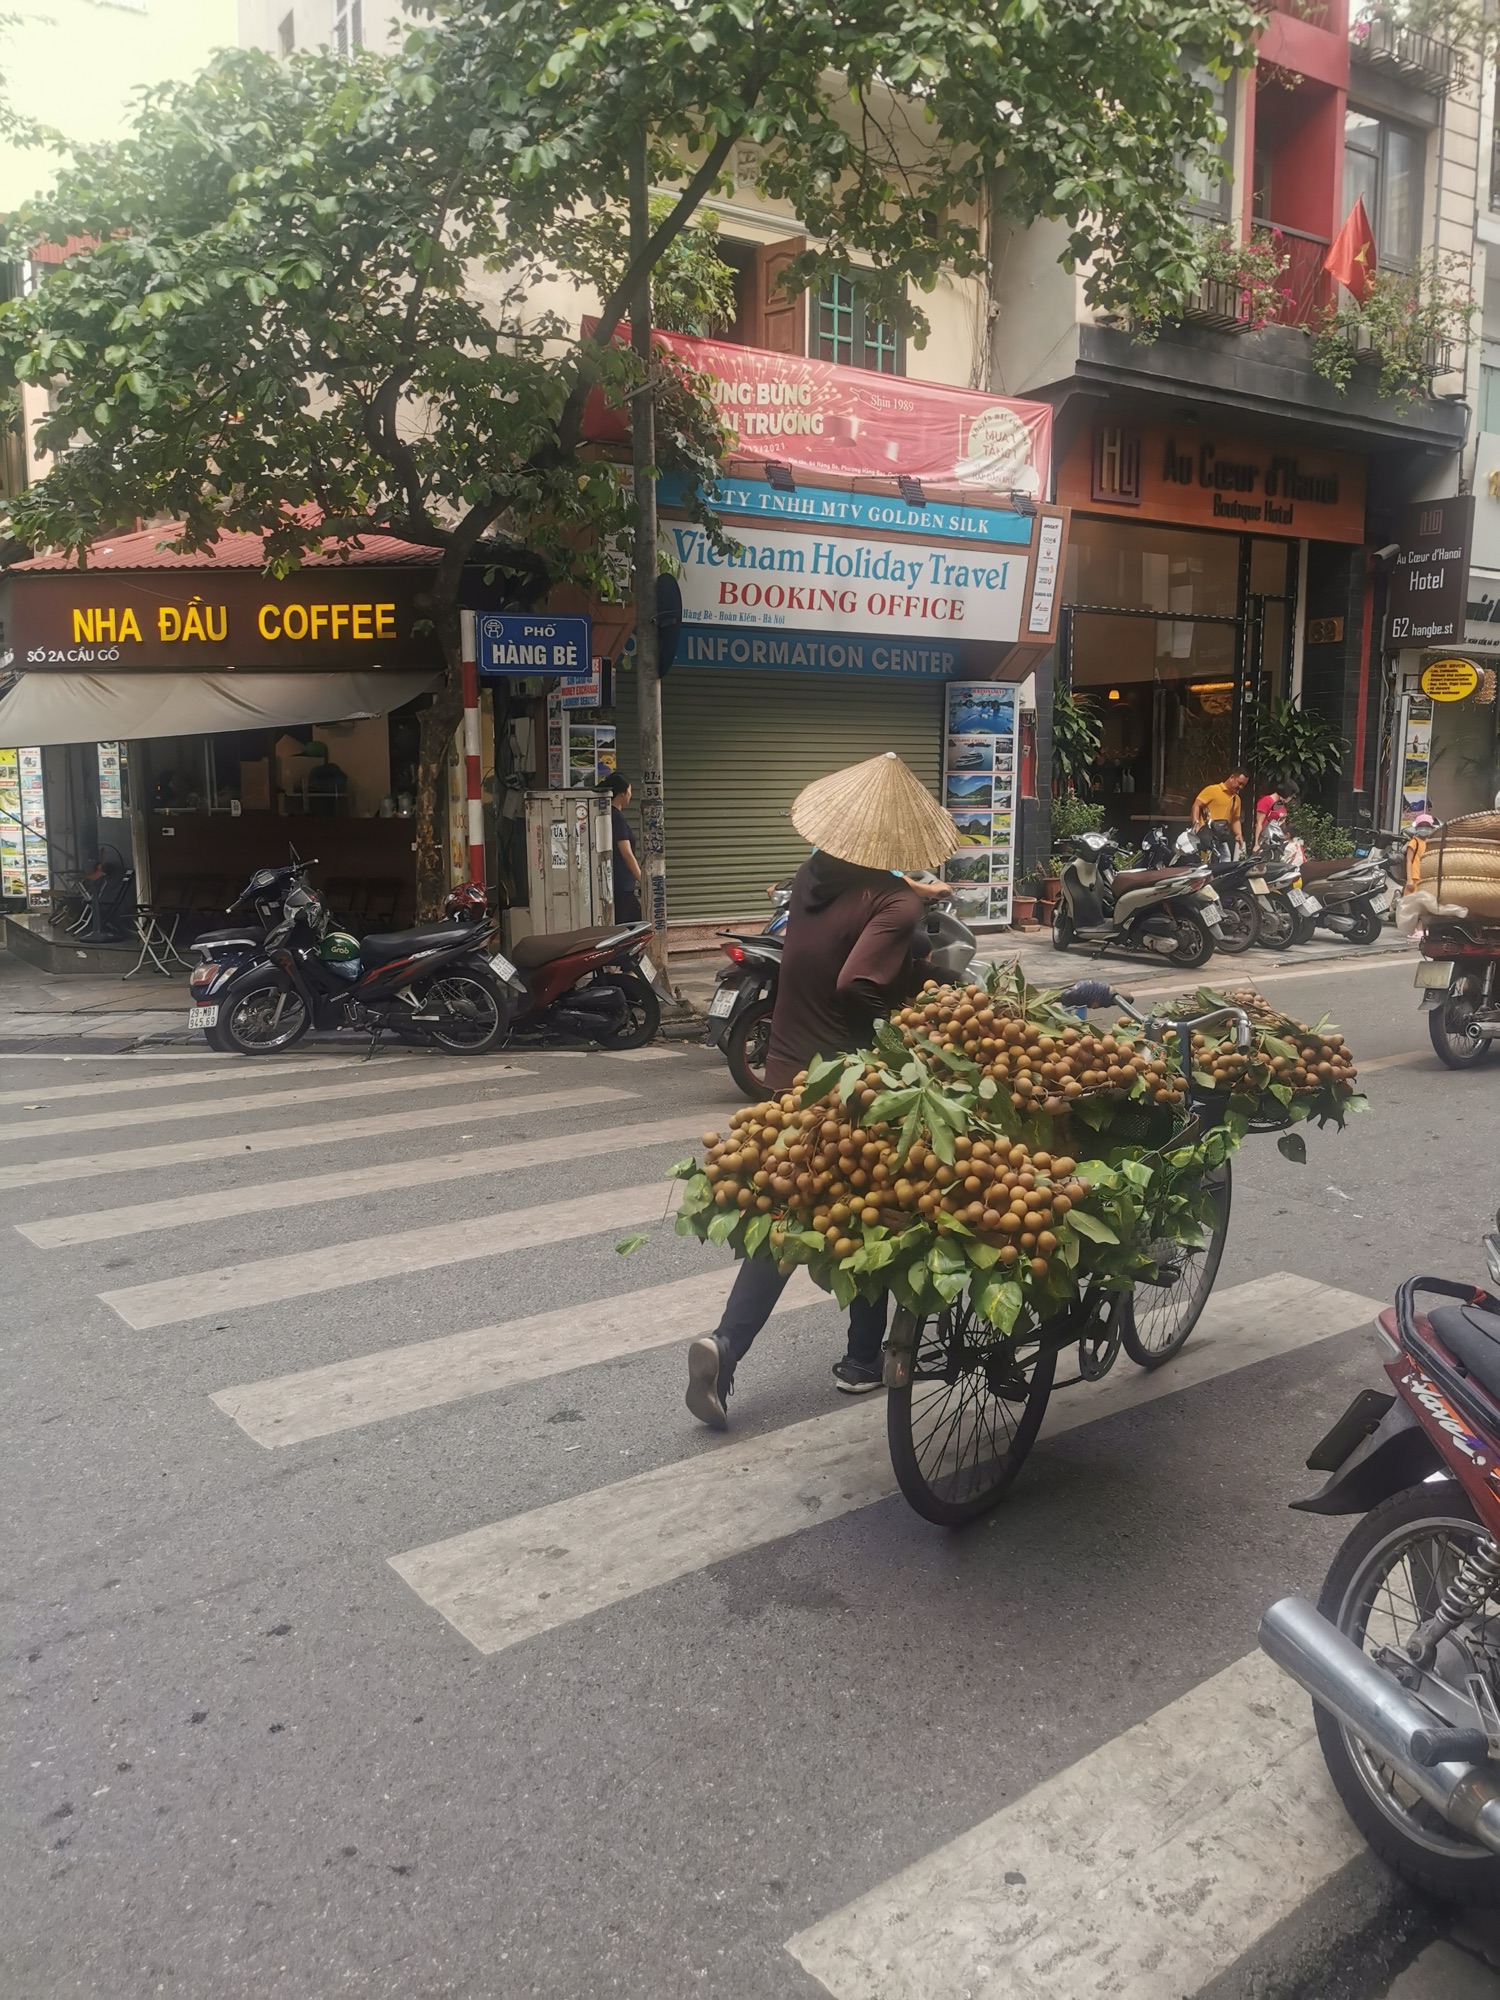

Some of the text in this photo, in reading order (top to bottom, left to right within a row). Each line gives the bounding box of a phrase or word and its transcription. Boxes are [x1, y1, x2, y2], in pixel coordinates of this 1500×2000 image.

[756, 377, 811, 406] BỪNG
[893, 397, 915, 413] 1989
[758, 493, 815, 514] TNHH
[821, 501, 864, 519] MTV
[868, 506, 945, 529] GOLDEN
[949, 516, 990, 534] SILK
[1213, 493, 1294, 525] Boutique Hotel
[810, 542, 924, 590] Holiday
[929, 552, 1010, 590] Travel
[1396, 552, 1407, 565] Au
[1409, 568, 1445, 591] Hotel
[718, 581, 965, 621] BOOKING OFFICE
[73, 595, 397, 643] NHA ĐẦU COFFEE
[683, 608, 702, 621] Hàng
[703, 609, 713, 620] Bè
[719, 610, 737, 622] Hoàn
[762, 613, 772, 624] Hà
[523, 623, 556, 638] PHỐ
[1392, 617, 1454, 639] 62 hangbe.st
[27, 646, 46, 663] SỐ
[48, 650, 66, 663] 2A
[67, 646, 95, 662] CẦU
[492, 639, 547, 665] HÀNG
[553, 640, 578, 666] BÈ
[687, 635, 954, 674] INFORMATION CENTER
[646, 787, 659, 796] 53
[331, 946, 350, 954] Grab
[189, 1016, 216, 1028] 945.69
